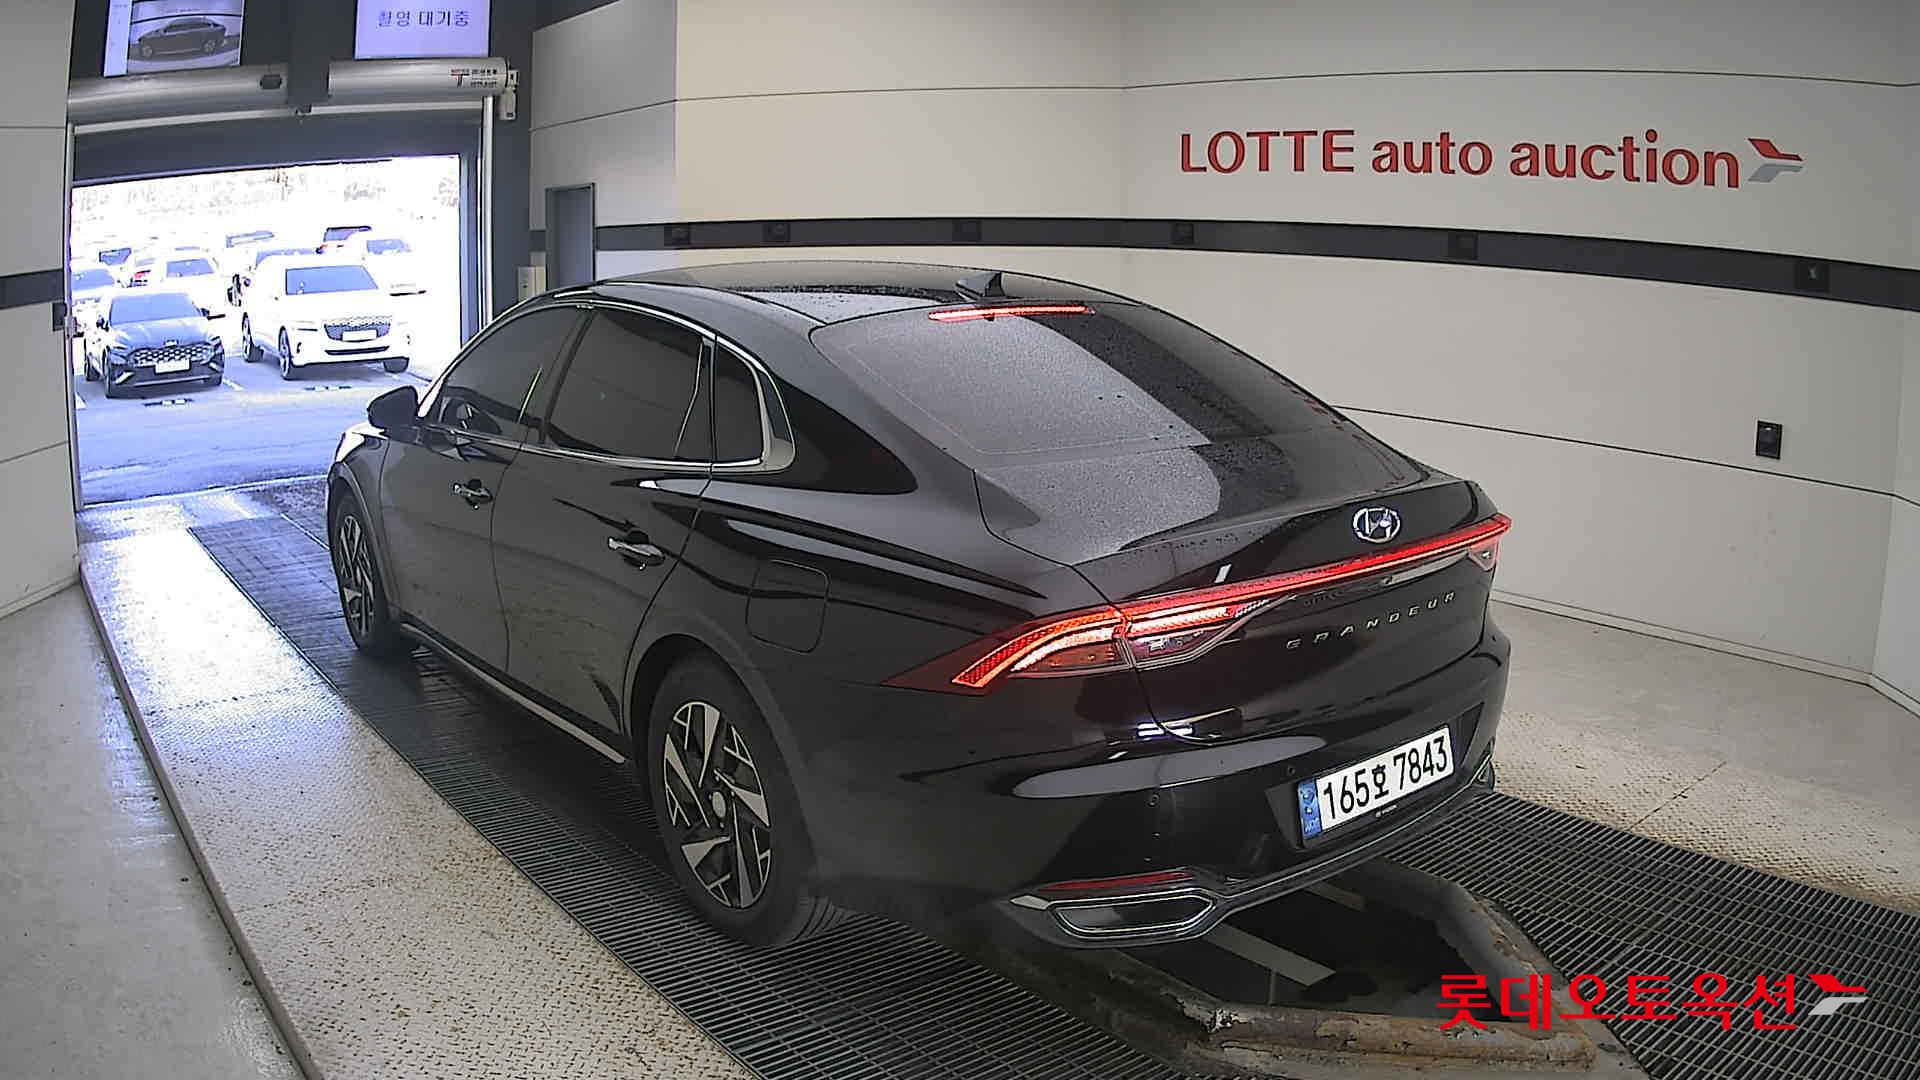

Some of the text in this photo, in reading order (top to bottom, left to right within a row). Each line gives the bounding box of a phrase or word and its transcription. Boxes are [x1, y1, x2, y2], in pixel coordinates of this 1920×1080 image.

[418, 10, 469, 27] 대기중
[1180, 129, 1740, 189] LOTTE auto auction
[1286, 592, 1456, 649] GRANDEUR
[1323, 735, 1448, 820] 165호 7843
